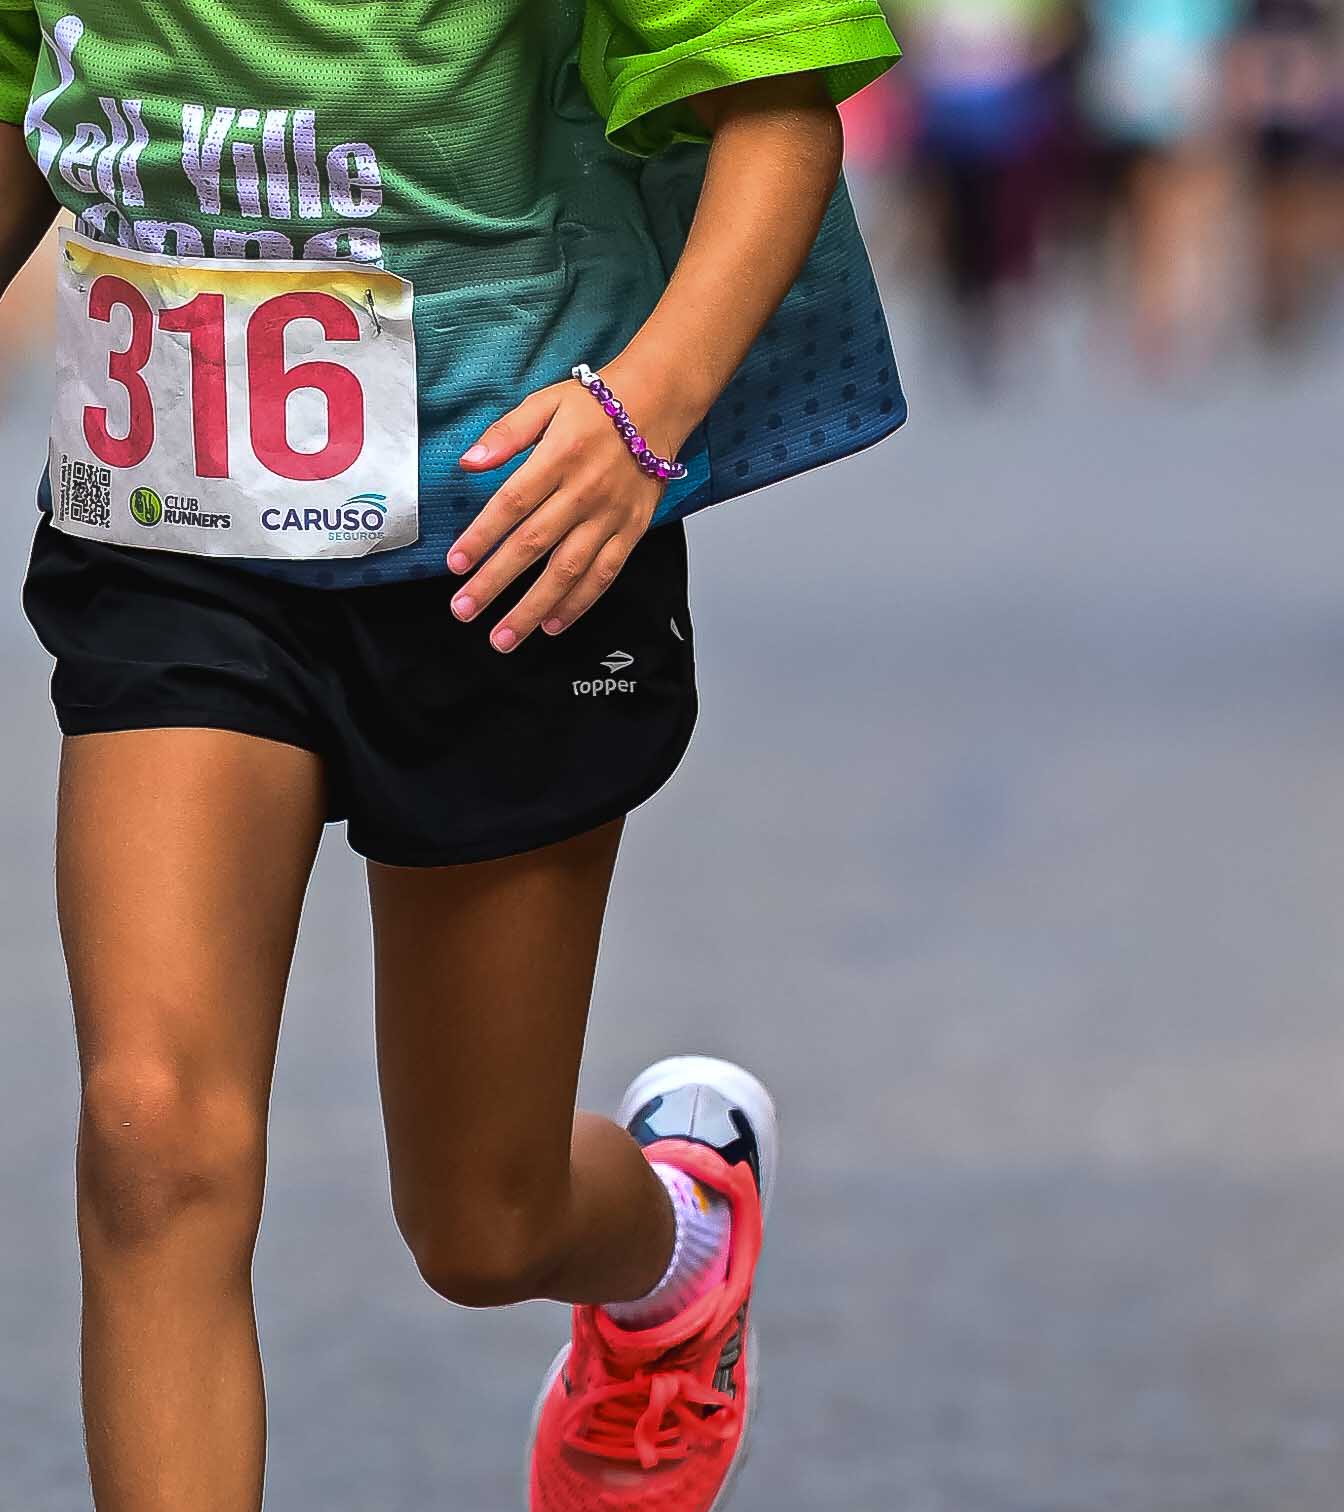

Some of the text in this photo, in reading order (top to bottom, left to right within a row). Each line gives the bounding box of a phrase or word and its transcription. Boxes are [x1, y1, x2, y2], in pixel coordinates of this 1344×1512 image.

[181, 103, 384, 220] Ville
[83, 275, 366, 482] 316
[164, 495, 199, 511] CLUB
[164, 510, 232, 529] RUNNER'S
[261, 508, 384, 531] CARUSO
[328, 531, 385, 541] SEGUROS
